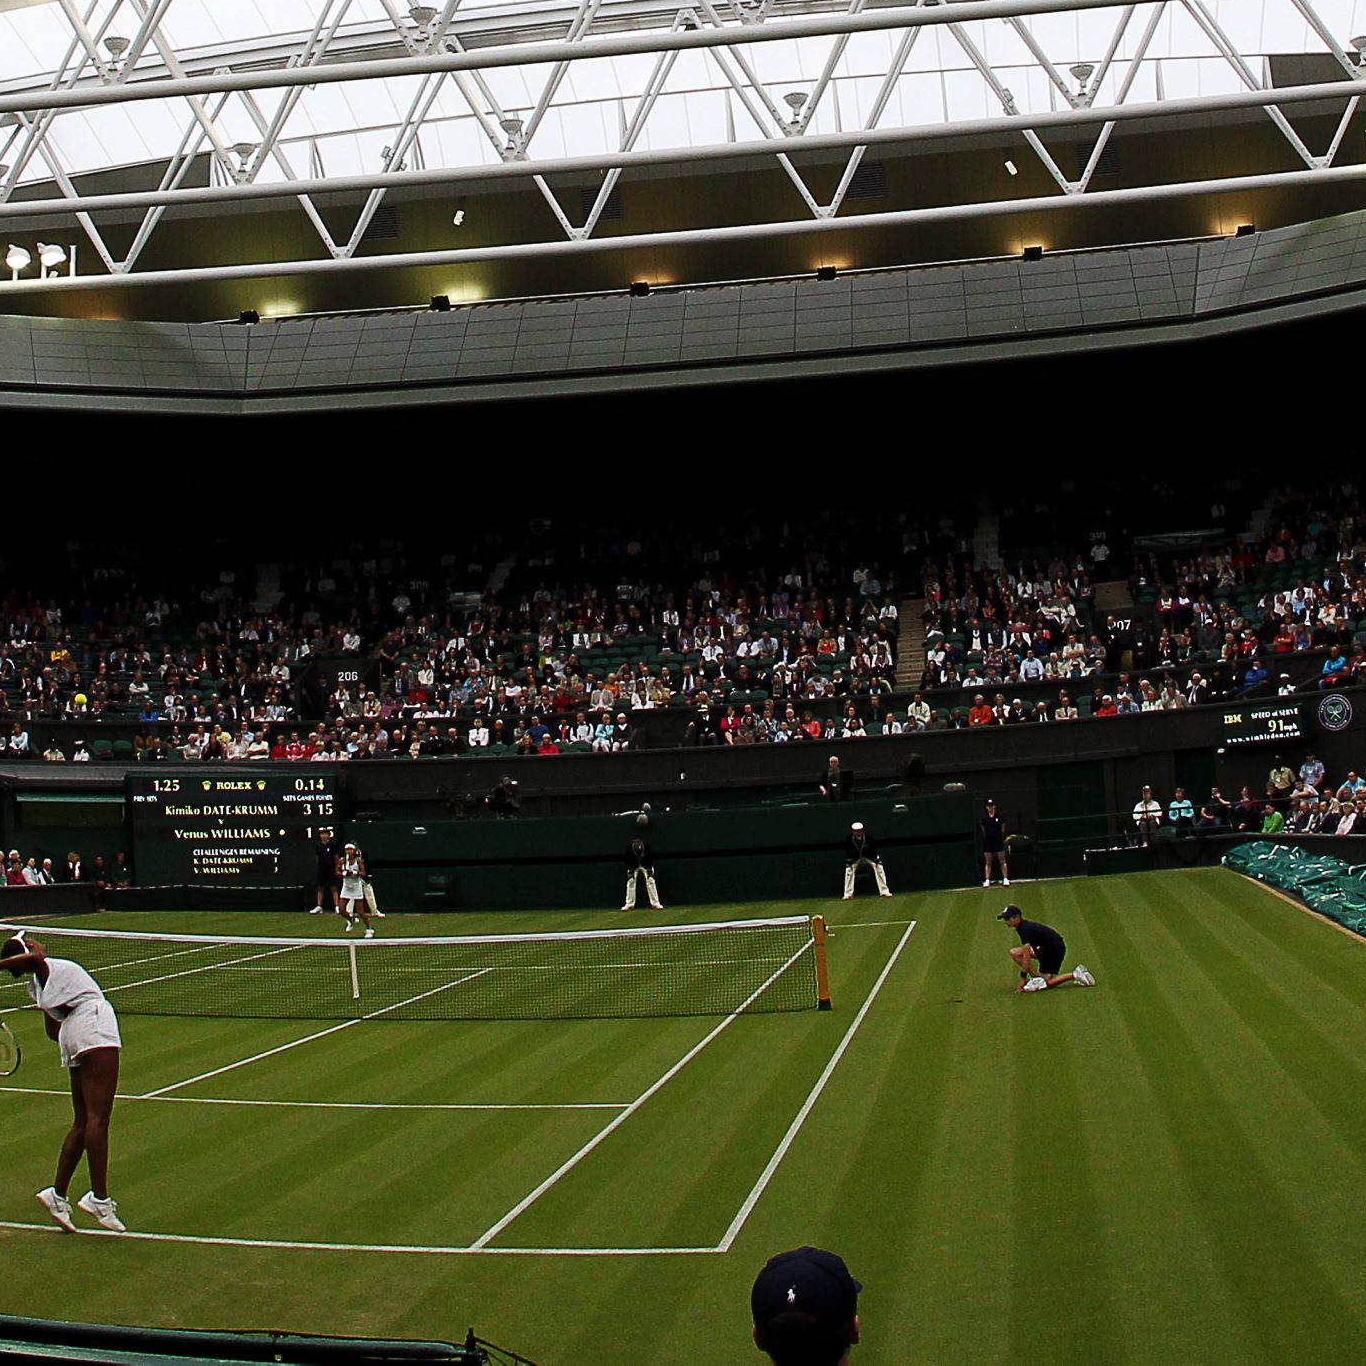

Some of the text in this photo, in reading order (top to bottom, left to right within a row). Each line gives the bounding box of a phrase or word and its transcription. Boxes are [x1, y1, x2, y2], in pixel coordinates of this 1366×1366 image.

[337, 671, 359, 682] 206
[1223, 714, 1243, 724] IBM
[1251, 711, 1271, 719] SPEED
[1278, 707, 1298, 716] SERVE
[1226, 730, 1301, 744] www.wimbledon.com
[153, 779, 180, 792] 1.25
[216, 781, 252, 790] ROLEX
[295, 778, 325, 791] 0.14
[165, 805, 278, 816] Kimiko DATE-KRUMM
[303, 803, 334, 815] 3 15
[174, 829, 271, 839] Venus WILLIAMS
[306, 827, 312, 839] 1
